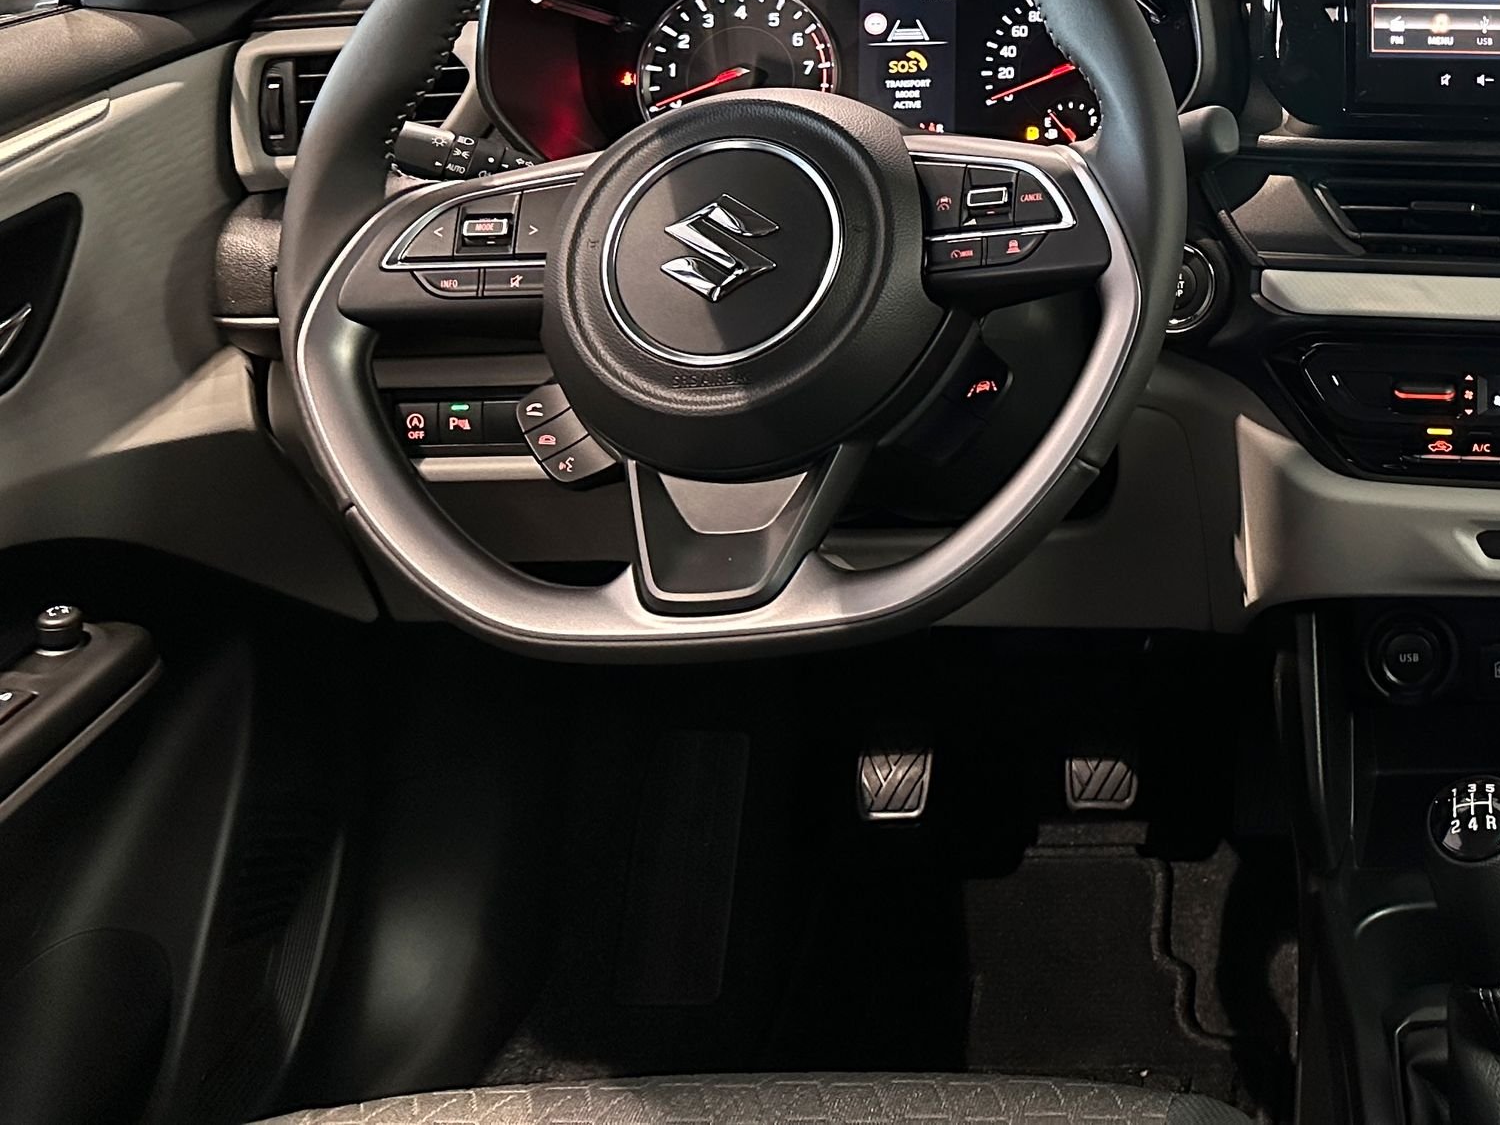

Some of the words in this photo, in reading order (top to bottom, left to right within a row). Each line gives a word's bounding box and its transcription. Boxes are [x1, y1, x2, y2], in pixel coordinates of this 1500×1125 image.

[734, 5, 748, 20] 4
[702, 13, 714, 28] 3
[768, 12, 780, 27] 5
[1011, 25, 1029, 38] 60
[677, 34, 690, 49] 2
[792, 32, 804, 47] 6
[1390, 35, 1404, 45] FM
[1427, 36, 1454, 46] MENU
[1476, 37, 1493, 46] USB
[999, 45, 1017, 58] 40
[668, 62, 677, 78] 1
[803, 60, 815, 75] 7
[888, 60, 918, 74] SOS
[997, 67, 1015, 79] 20
[885, 78, 931, 89] TRANSPORT
[895, 89, 920, 99] MODE
[893, 100, 922, 110] ACTIVE
[1044, 116, 1052, 128] E
[1090, 115, 1098, 126] F
[445, 163, 466, 175] AUTO
[1020, 192, 1044, 202] CANCEL
[475, 222, 495, 232] MODE
[441, 279, 458, 289] INFO
[408, 431, 425, 440] OFF
[1472, 443, 1491, 453] A/C
[1399, 653, 1419, 663] USB
[1451, 788, 1457, 797] 1
[1467, 783, 1477, 793] 3
[1485, 783, 1495, 793] 5
[1450, 819, 1461, 834] 2
[1468, 816, 1478, 831] 4
[1486, 815, 1497, 830] R
